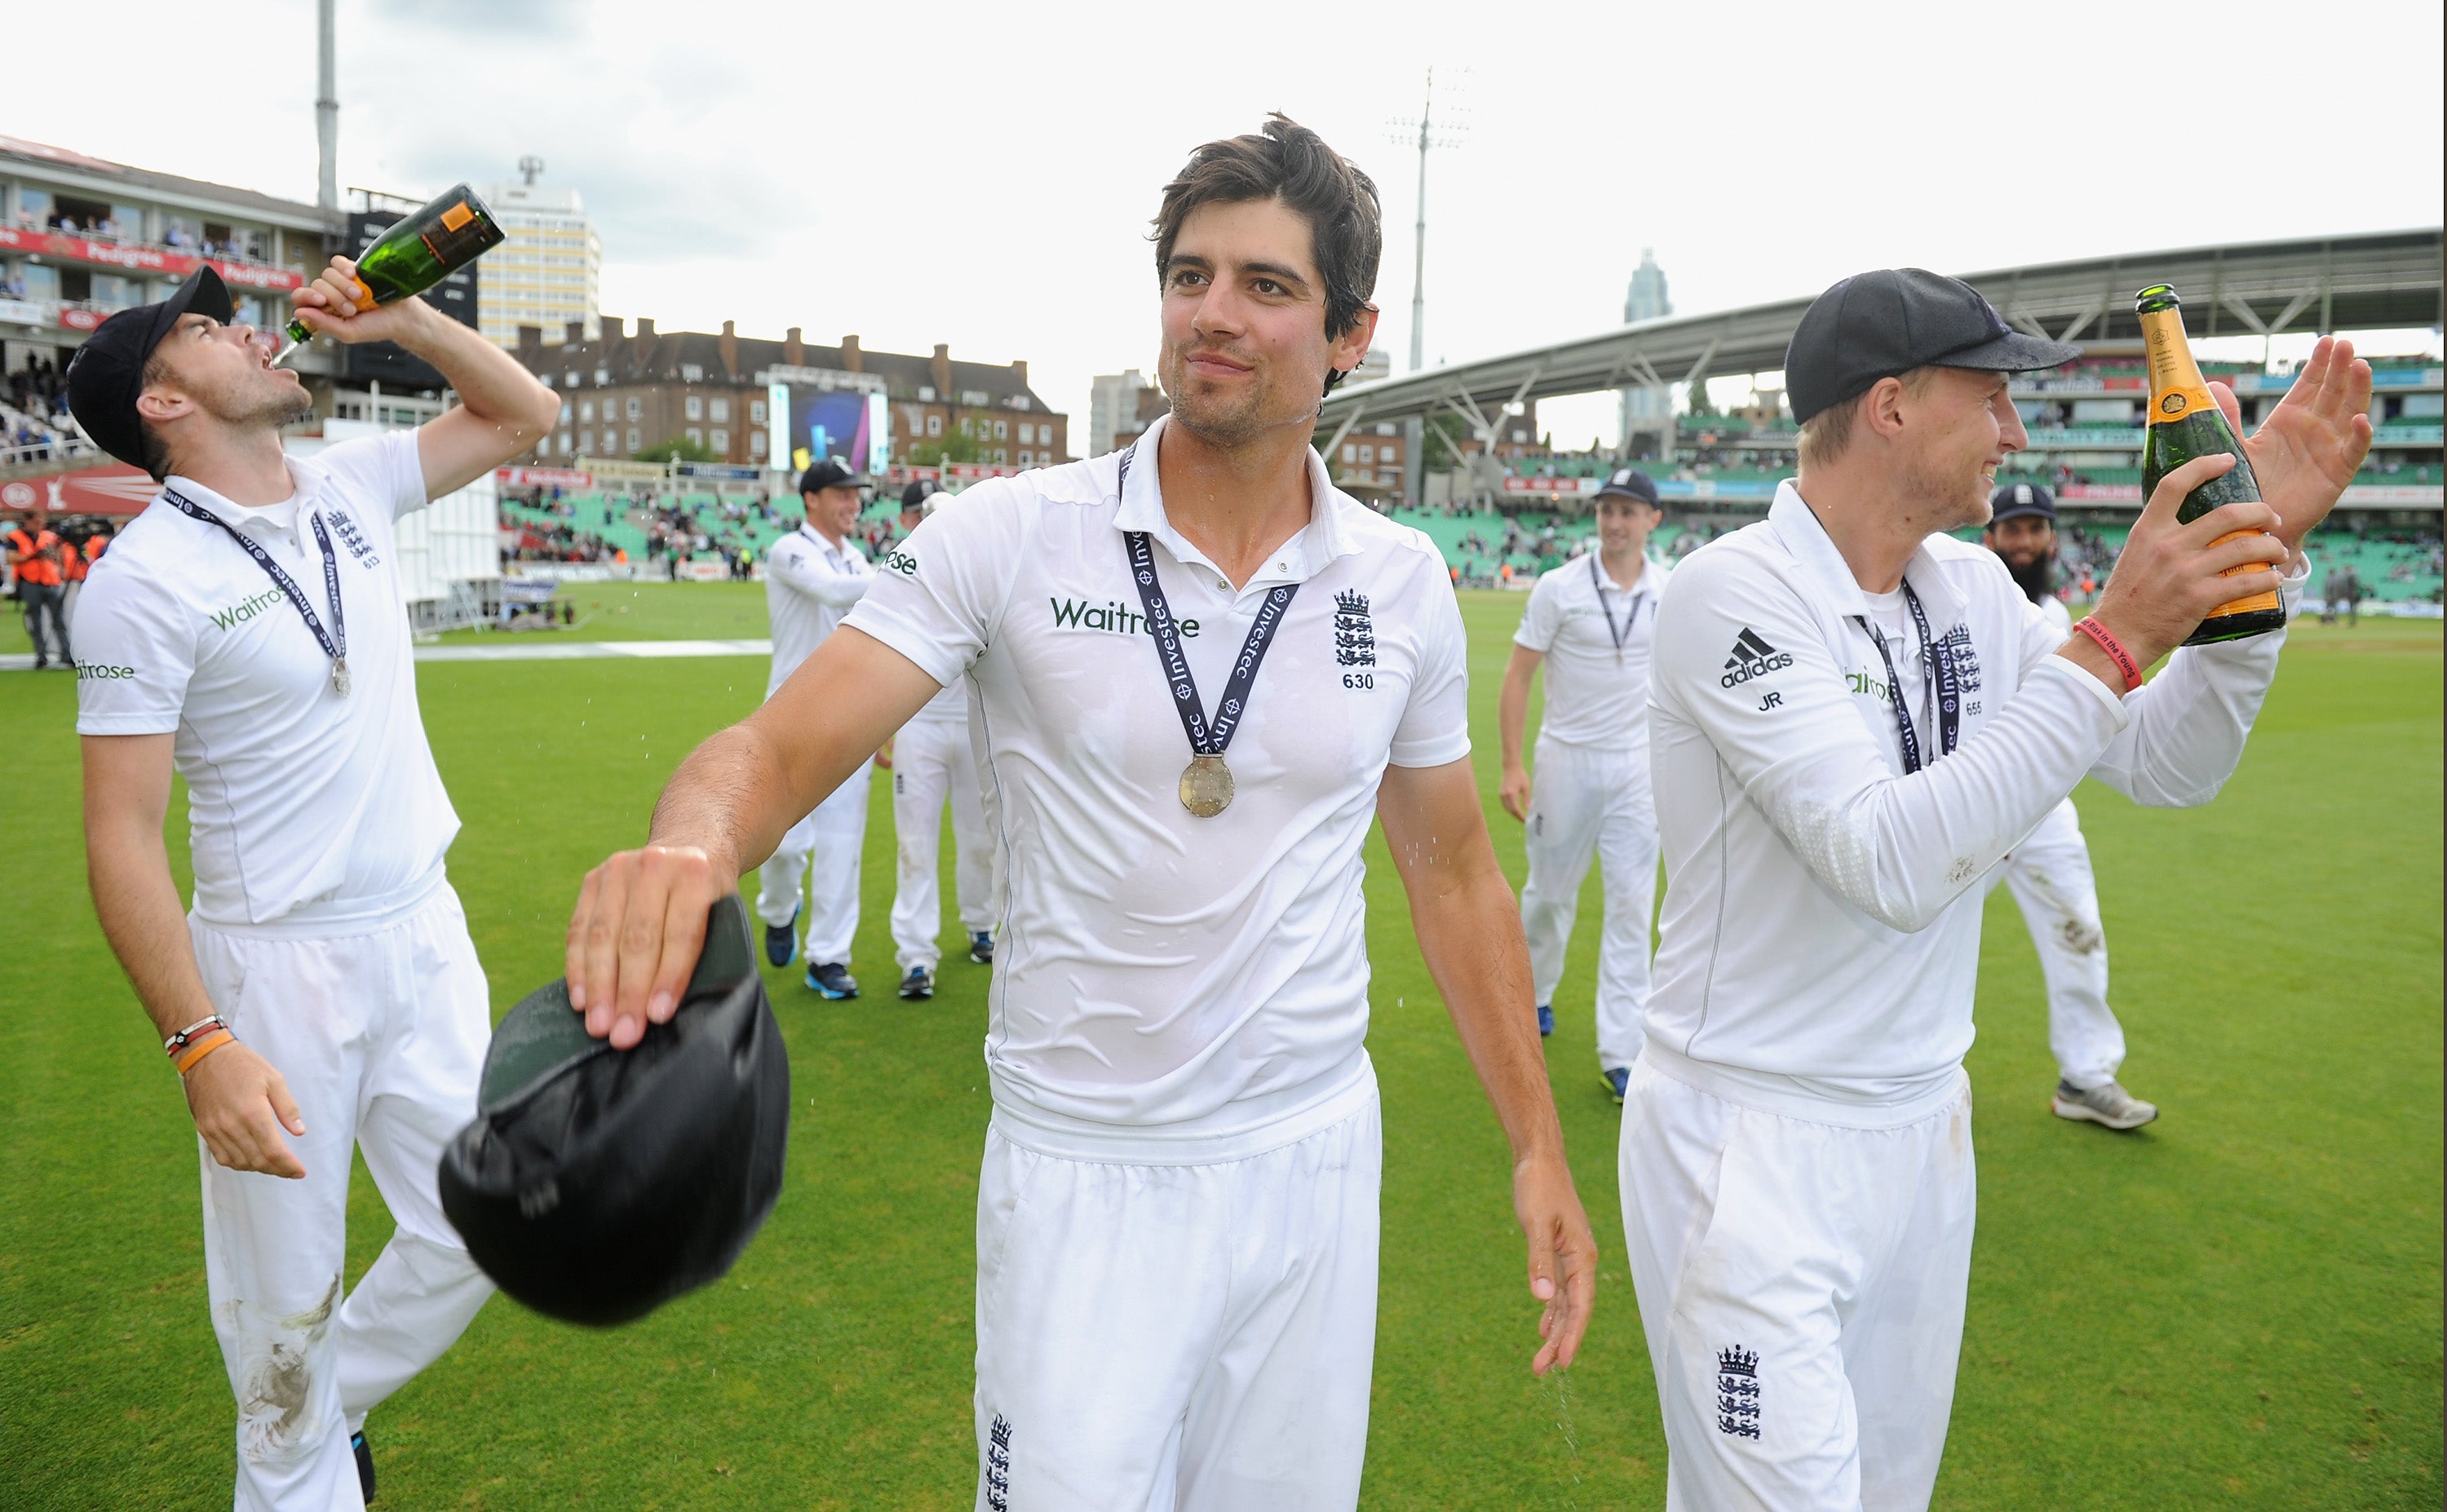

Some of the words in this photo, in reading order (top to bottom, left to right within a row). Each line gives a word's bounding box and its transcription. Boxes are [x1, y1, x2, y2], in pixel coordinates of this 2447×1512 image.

[363, 556, 380, 569] 613
[210, 582, 292, 632] Waitros
[270, 565, 311, 615] Investec
[325, 563, 341, 617] Investec
[1150, 597, 1187, 683] Investec
[1237, 603, 1281, 679] Investec
[1909, 595, 1931, 663] Investec
[2088, 622, 2102, 636] Risk
[2100, 634, 2108, 642] in
[2107, 641, 2119, 653] the
[2118, 652, 2135, 679] Young
[1342, 674, 1374, 689] 630
[1721, 653, 1794, 688] adidas
[1758, 692, 1784, 712] JR
[1967, 701, 1982, 716] 655
[1213, 715, 1235, 750] Inv
